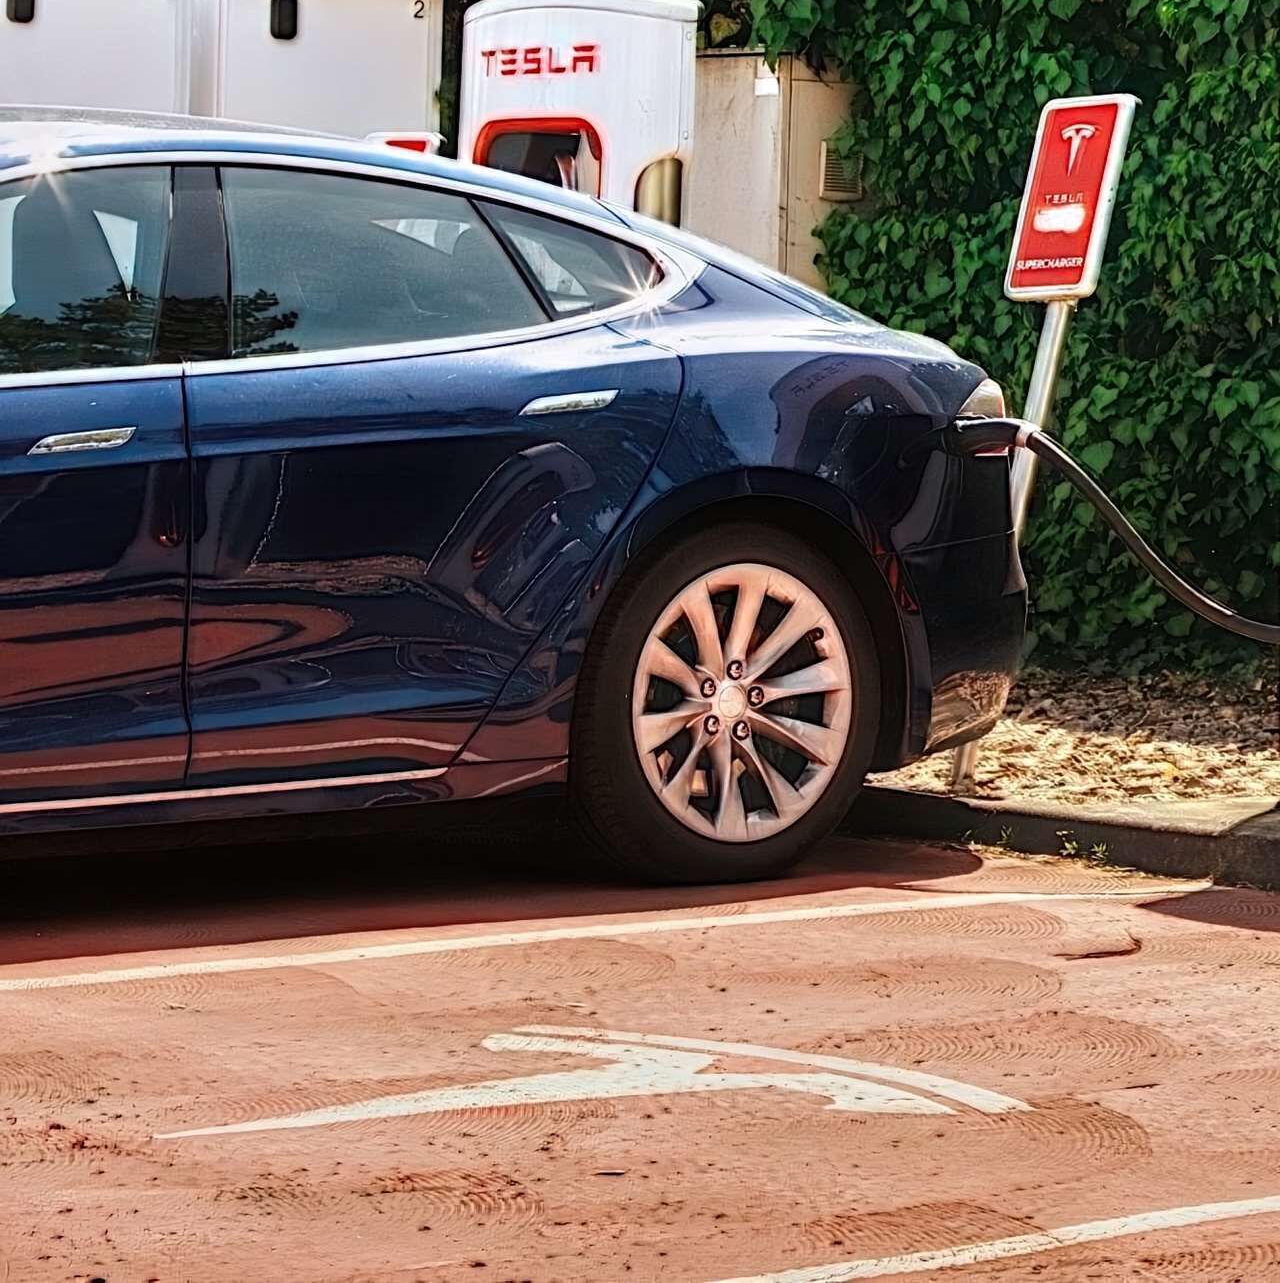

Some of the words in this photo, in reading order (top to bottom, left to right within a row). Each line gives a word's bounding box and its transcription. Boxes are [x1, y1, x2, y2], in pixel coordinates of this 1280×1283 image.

[413, 0, 425, 19] 2
[481, 44, 599, 76] TESLA
[1044, 193, 1084, 205] TESLA
[1015, 256, 1084, 271] SUPERCHARGER
